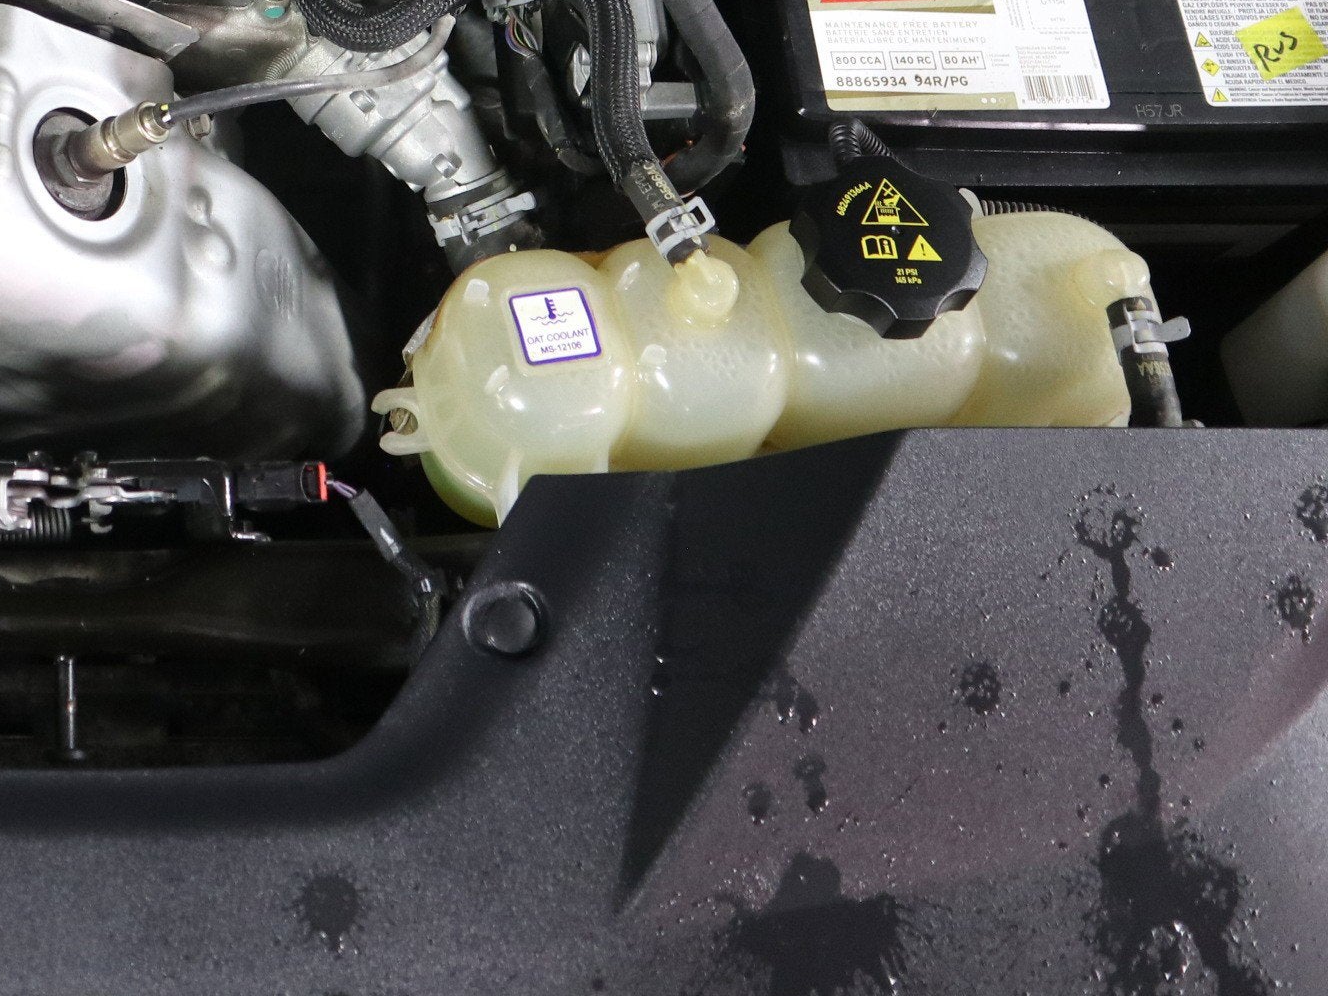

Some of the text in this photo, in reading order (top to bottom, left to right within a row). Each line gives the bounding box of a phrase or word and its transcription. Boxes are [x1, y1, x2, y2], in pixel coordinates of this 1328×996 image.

[825, 21, 978, 29] MAINTENANCE FREE BATTERY
[835, 56, 882, 65] 800 CCA
[894, 56, 932, 65] 140 RC
[944, 56, 958, 65] 80
[836, 75, 969, 88] 88865934 94R/PG
[836, 181, 872, 216] 68249136AA
[896, 268, 918, 276] 21 PSI
[895, 276, 922, 284] 145 kPa
[527, 328, 589, 345] OAT COOLANT
[540, 341, 582, 354] MS-12106
